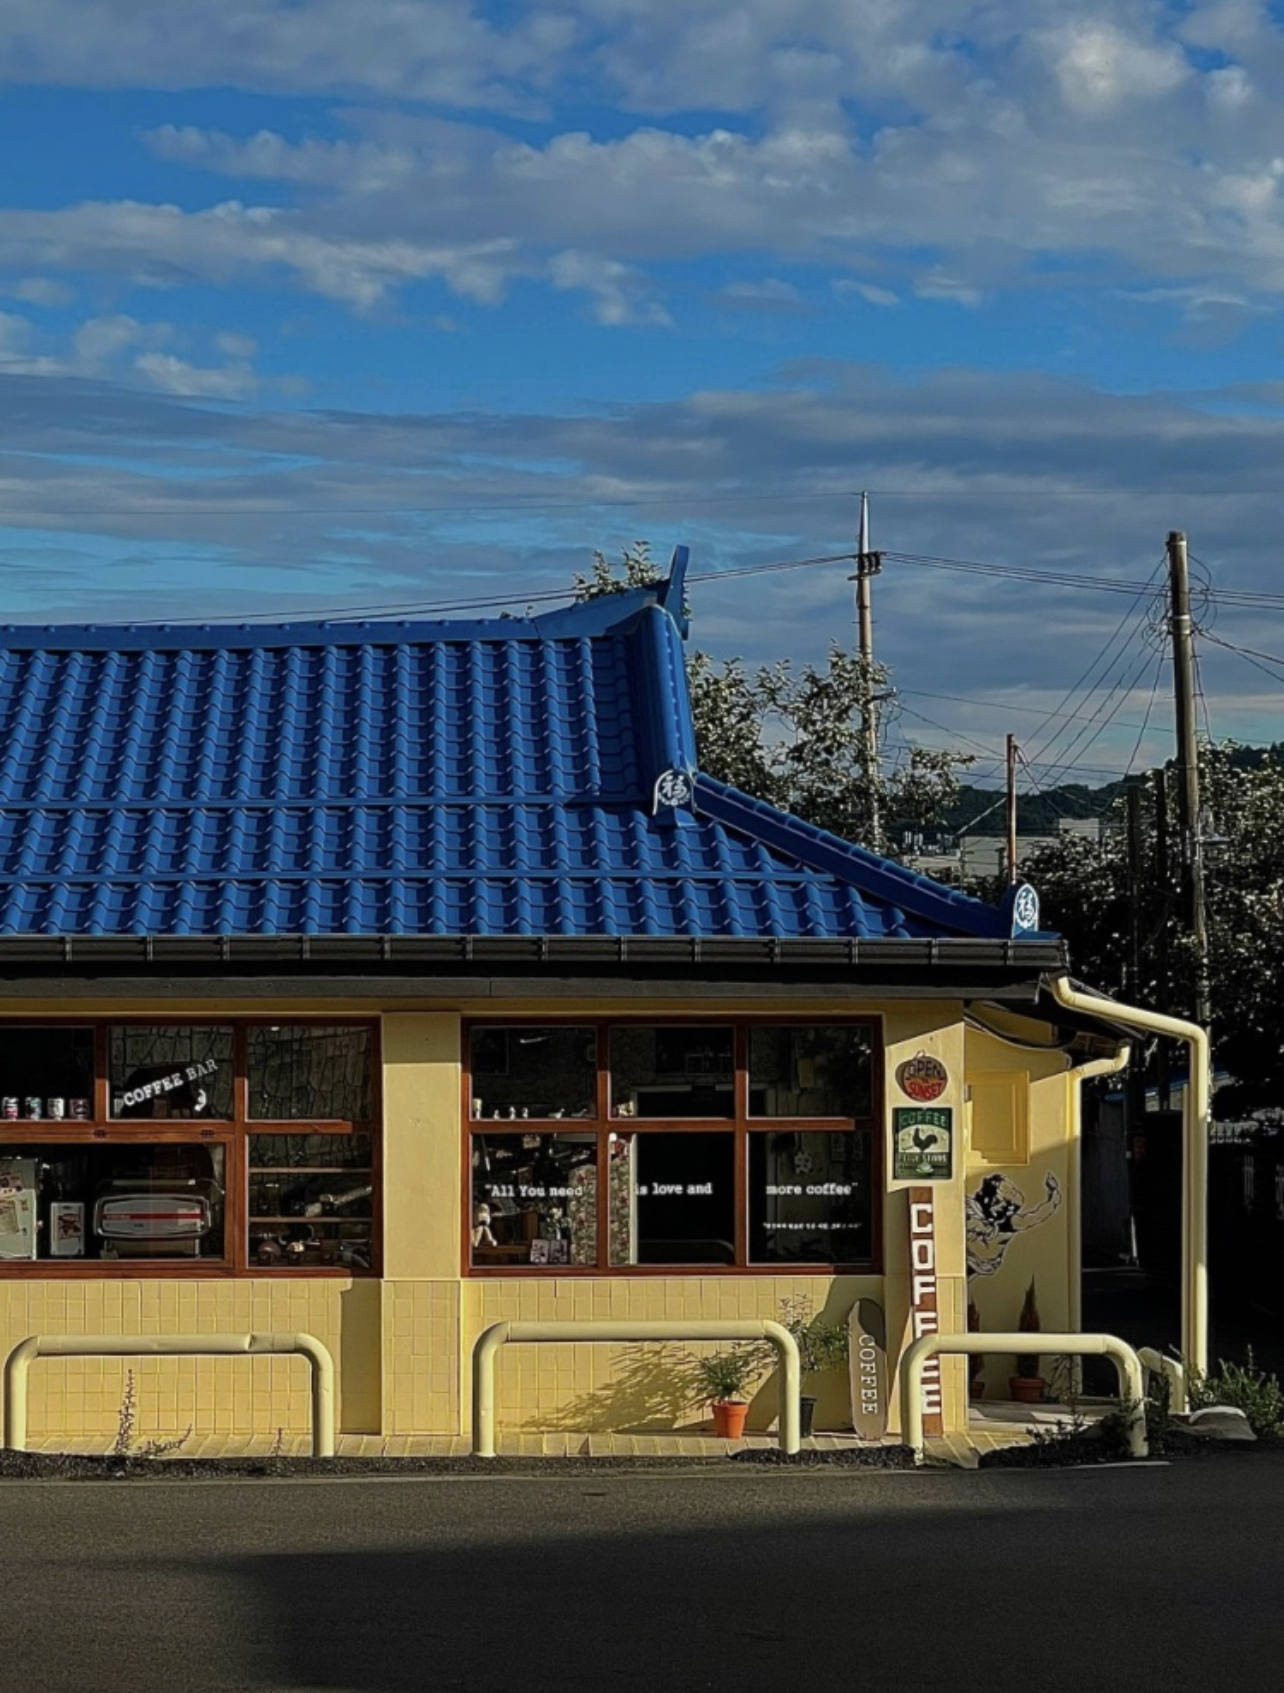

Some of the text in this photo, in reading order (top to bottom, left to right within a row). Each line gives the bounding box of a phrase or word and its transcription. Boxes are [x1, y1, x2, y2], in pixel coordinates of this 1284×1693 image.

[908, 1060, 943, 1077] OPEN
[123, 1059, 218, 1107] COFFEE BAR
[909, 1081, 942, 1100] SUNSET
[900, 1110, 947, 1127] COFFEE
[519, 1185, 546, 1198] You
[652, 1182, 683, 1196] love
[687, 1182, 713, 1196] and
[766, 1185, 802, 1196] more
[859, 1334, 878, 1415] COFFEE
